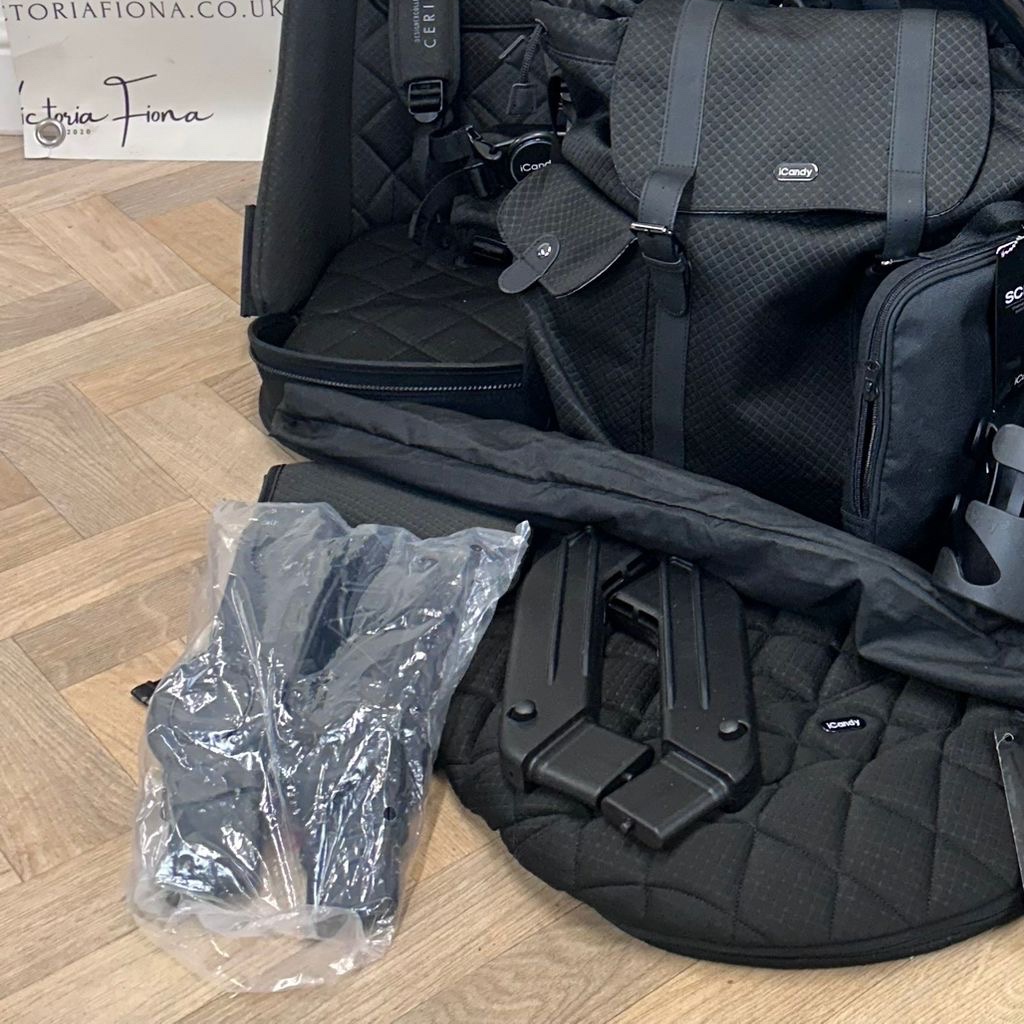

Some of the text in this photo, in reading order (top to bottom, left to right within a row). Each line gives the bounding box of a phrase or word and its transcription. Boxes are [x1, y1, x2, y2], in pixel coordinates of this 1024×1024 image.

[103, 74, 214, 148] Fiona
[778, 167, 813, 178] iCandy
[825, 718, 861, 730] iCandy
